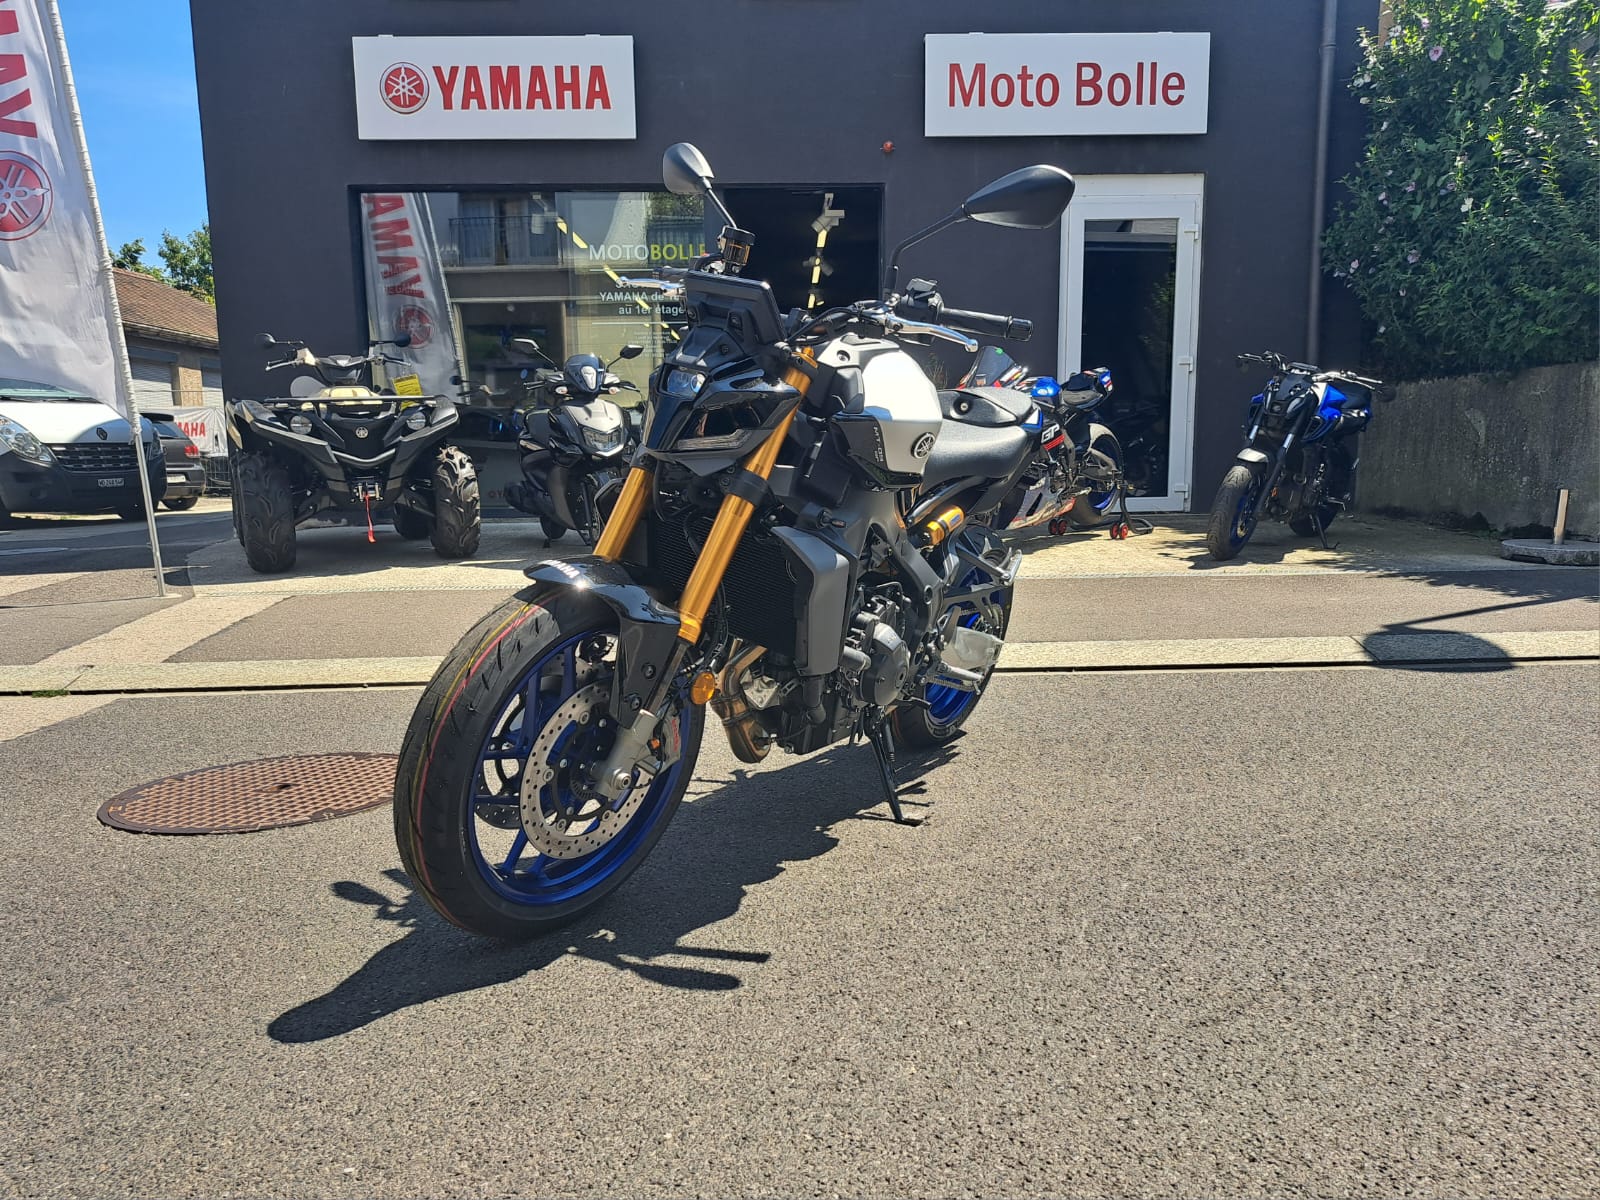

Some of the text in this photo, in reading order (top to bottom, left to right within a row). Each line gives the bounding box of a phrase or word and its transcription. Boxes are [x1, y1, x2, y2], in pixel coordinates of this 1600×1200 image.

[432, 65, 611, 110] YAMAHA
[949, 62, 1186, 107] Moto Bolle
[600, 291, 647, 301] YAMAHA
[651, 290, 665, 301] de
[1041, 423, 1060, 443] GP
